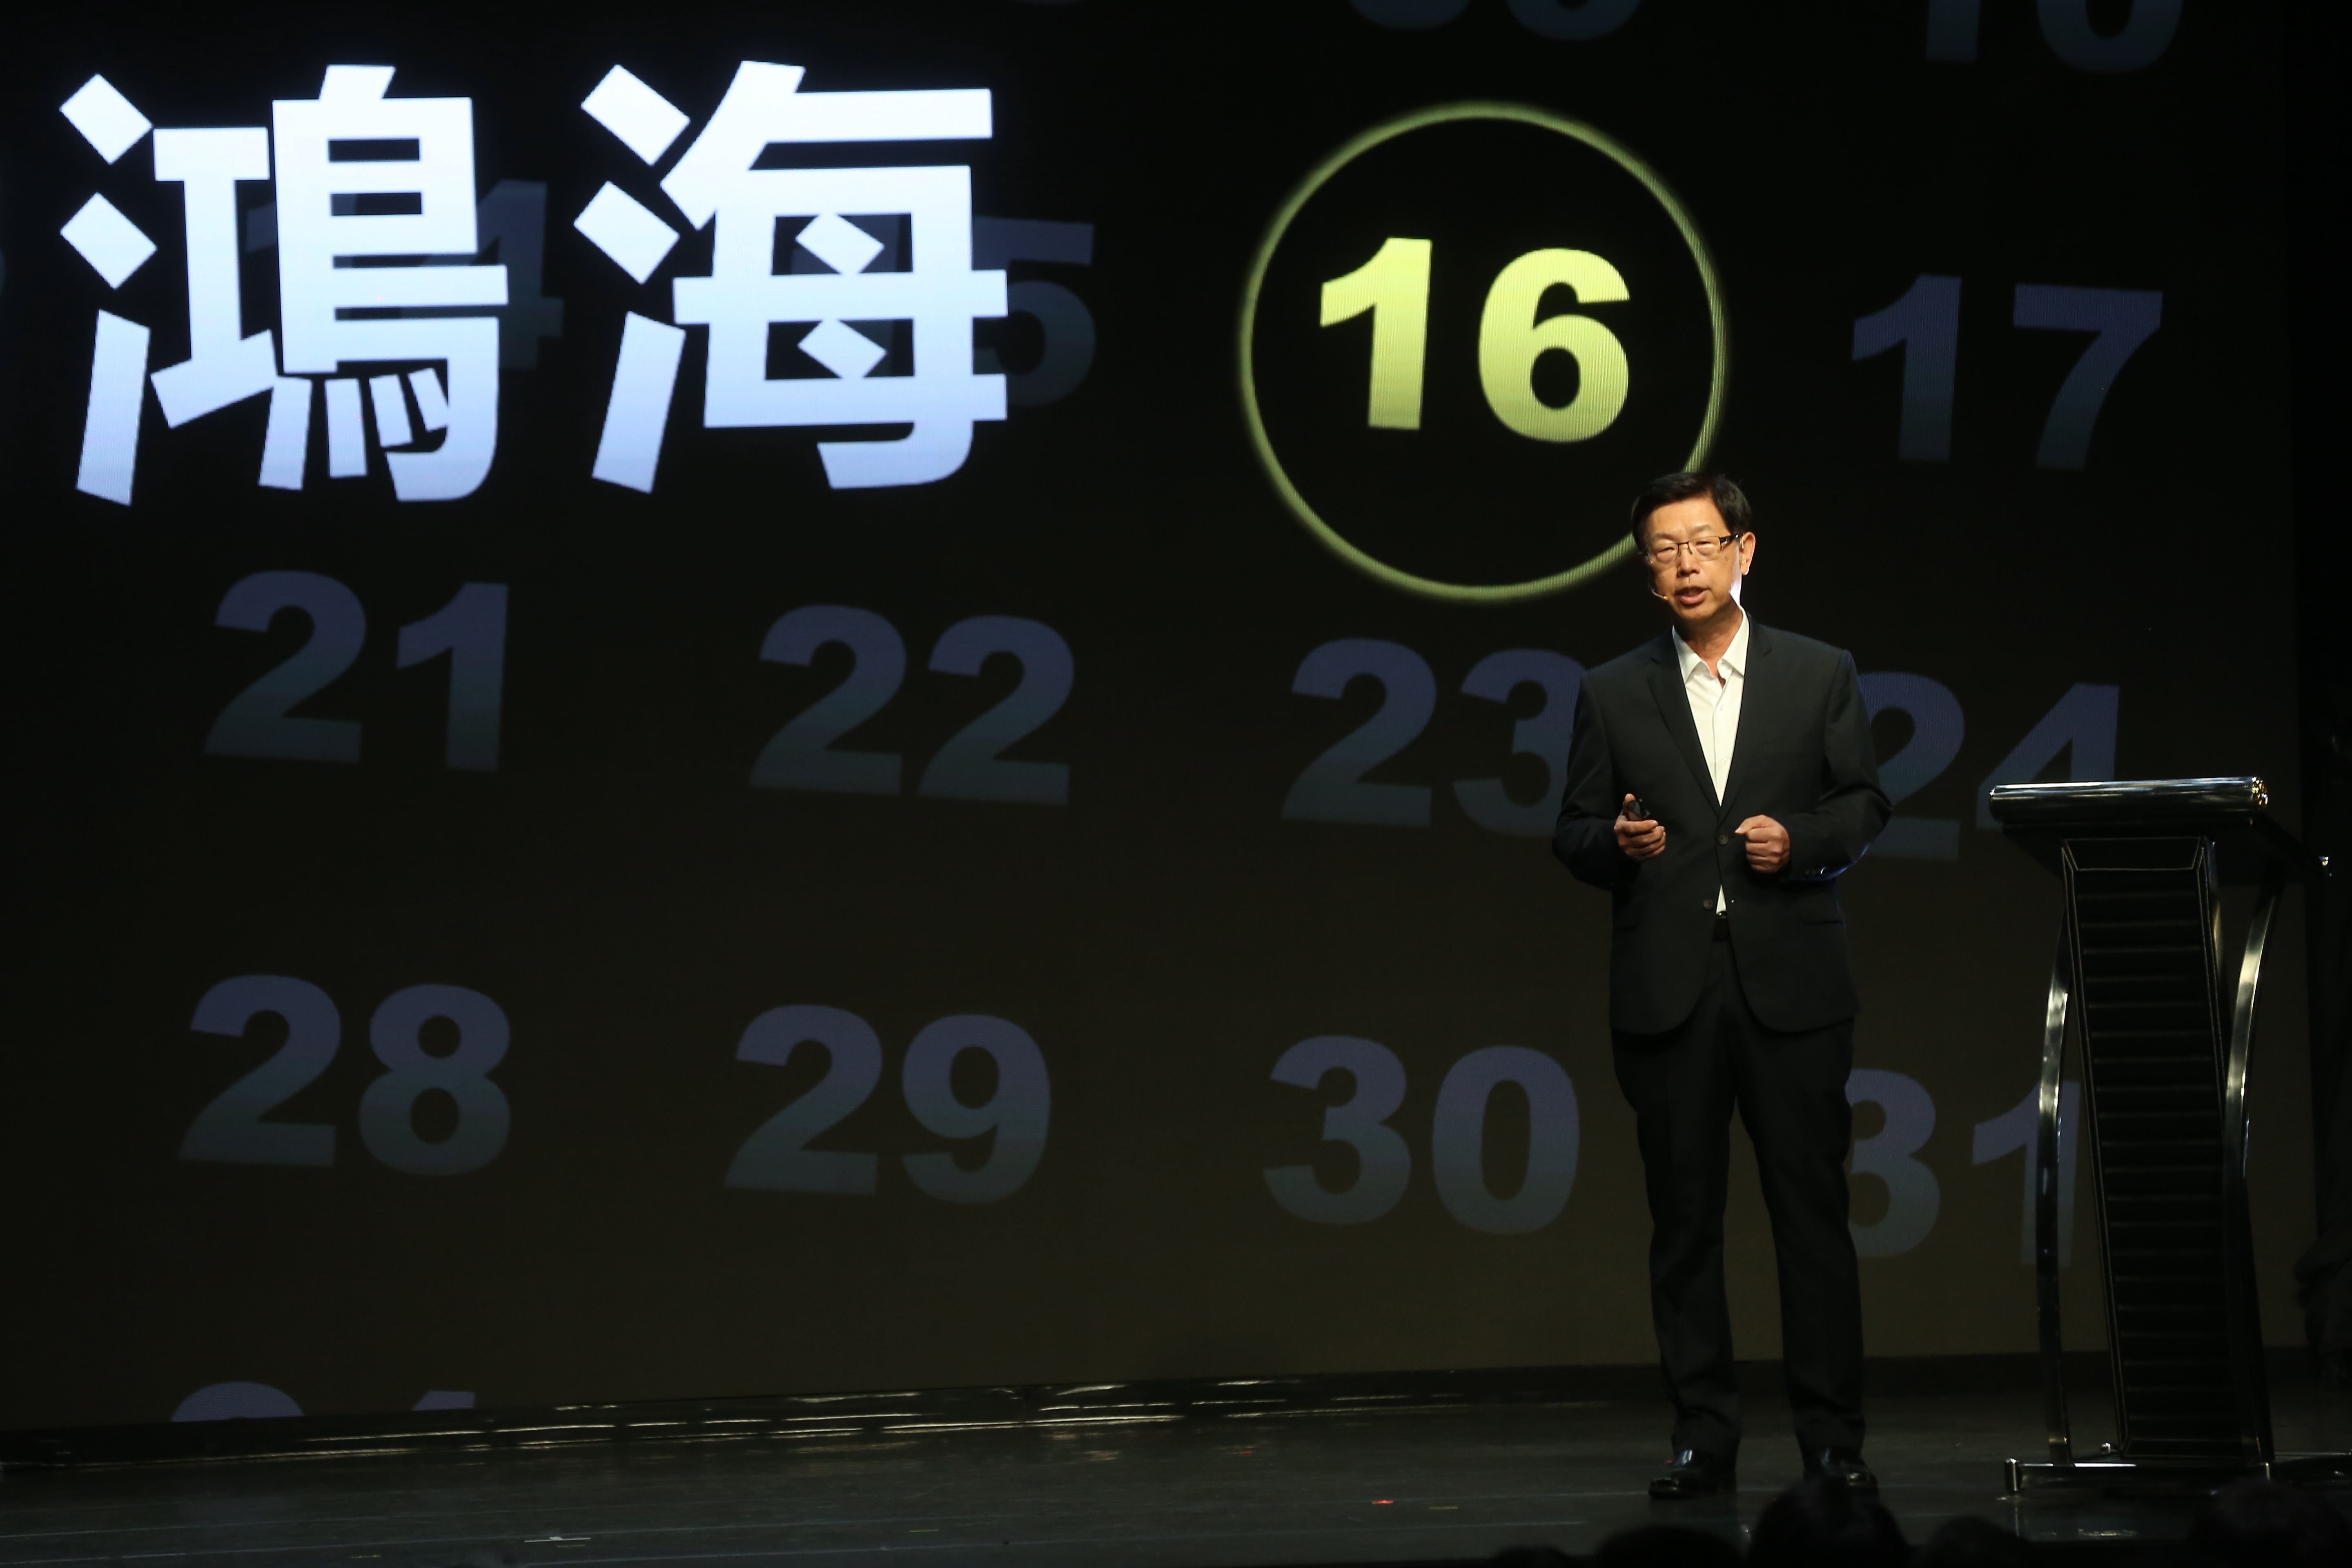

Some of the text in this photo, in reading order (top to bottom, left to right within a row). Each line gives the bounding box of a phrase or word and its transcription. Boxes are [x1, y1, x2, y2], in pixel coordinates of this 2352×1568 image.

[58, 60, 1009, 506] 鴻海
[1319, 236, 1630, 443] 16
[1851, 273, 2163, 471] 17
[203, 569, 509, 772] 21
[749, 604, 1075, 806] 22
[1281, 638, 1585, 838] 23
[177, 974, 511, 1176] 28
[724, 1004, 1051, 1205] 29
[1263, 1035, 1580, 1235] 30
[1844, 1068, 2081, 1267] 31
